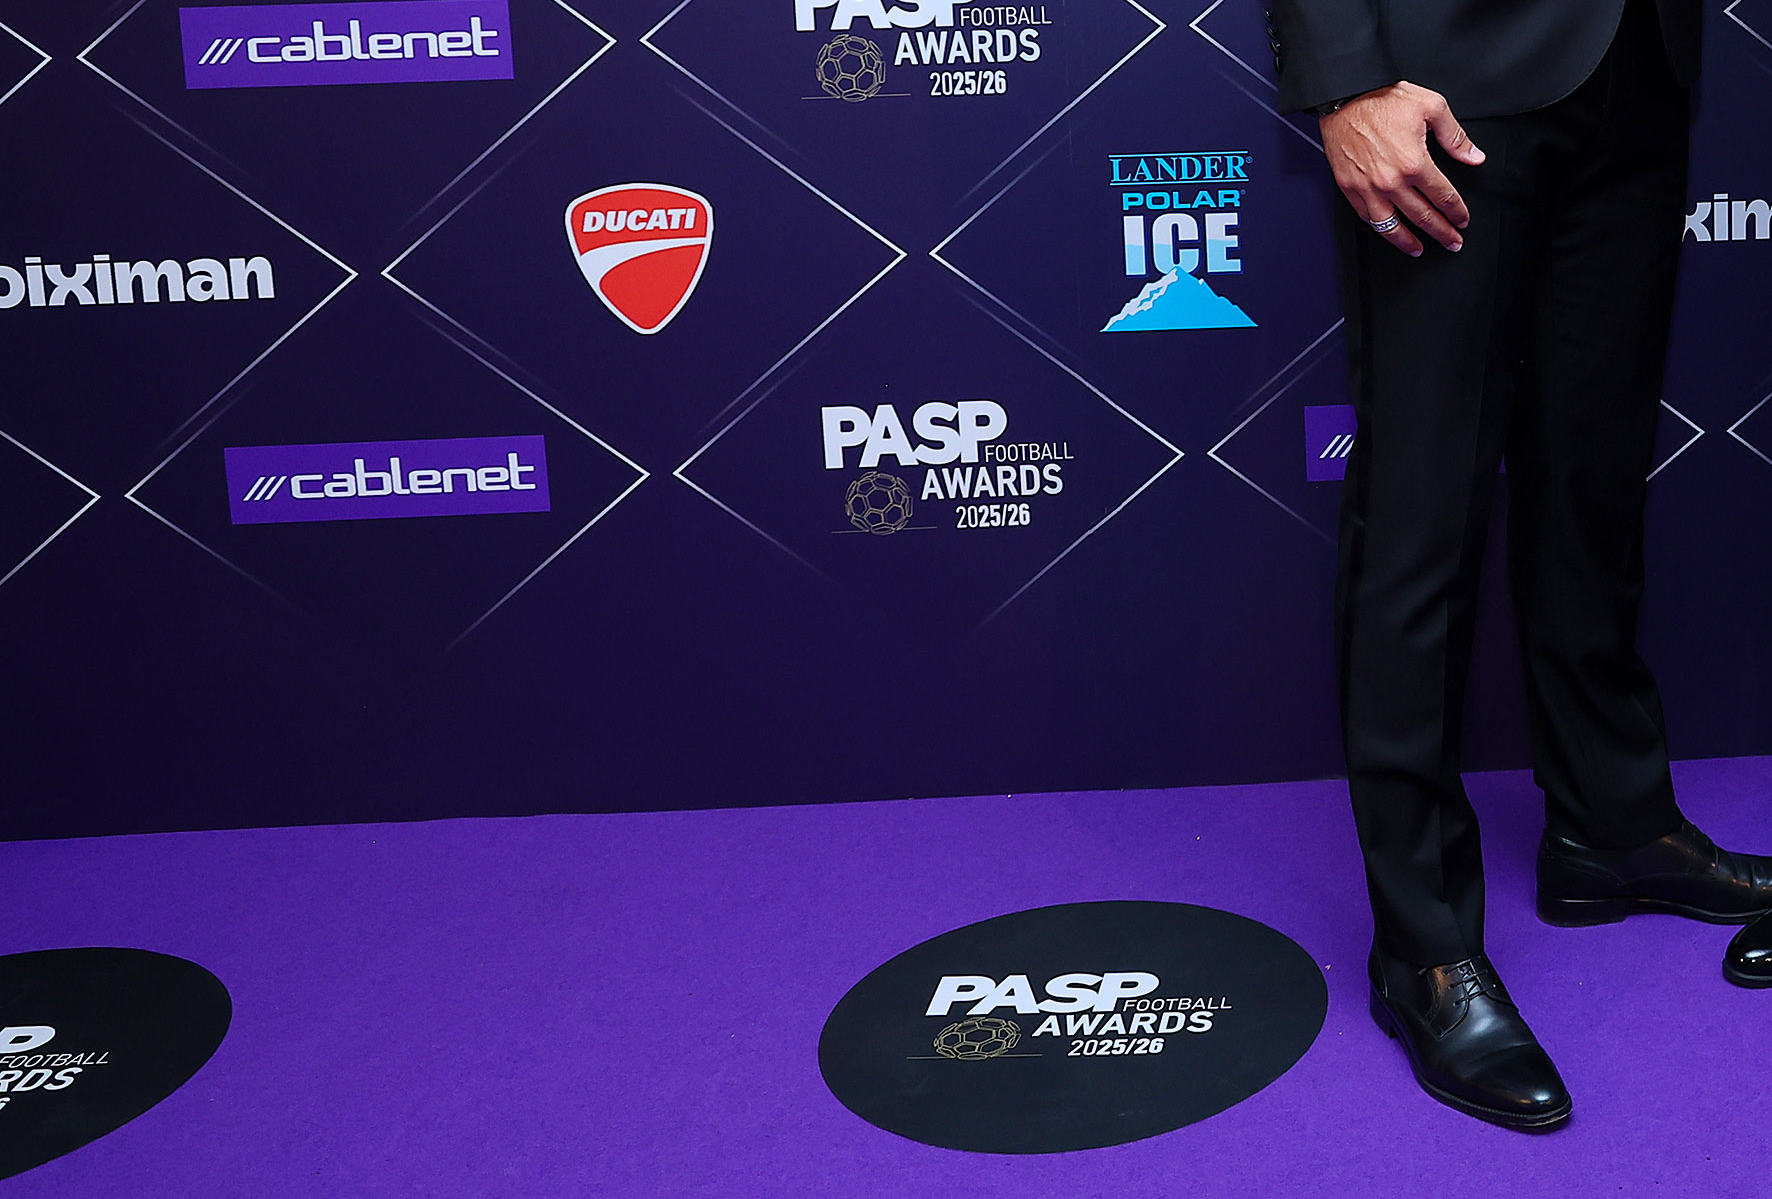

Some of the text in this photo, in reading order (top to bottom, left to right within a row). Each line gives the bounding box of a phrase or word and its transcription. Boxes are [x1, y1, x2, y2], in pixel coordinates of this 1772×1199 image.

[960, 5, 1053, 27] FOOTBALL
[247, 16, 500, 63] cablenet
[894, 28, 1041, 66] AWARDS
[929, 70, 1007, 96] 2025/26
[1122, 189, 1241, 211] POLAR
[582, 207, 697, 233] DUCATI
[1123, 212, 1242, 277] ICE
[0, 254, 275, 308] oiximan
[821, 400, 1008, 470] PASP
[984, 441, 1075, 463] FOOTBALL
[290, 452, 536, 499] cablenet
[920, 463, 1063, 501] AWARDS
[955, 503, 1031, 529] 2025/26
[925, 971, 1160, 1016] PASP
[1122, 996, 1232, 1012] FOOTBALL
[1031, 1010, 1214, 1037] AWARDS
[1067, 1037, 1165, 1057] 2025/26
[0, 1067, 83, 1092] RDS
